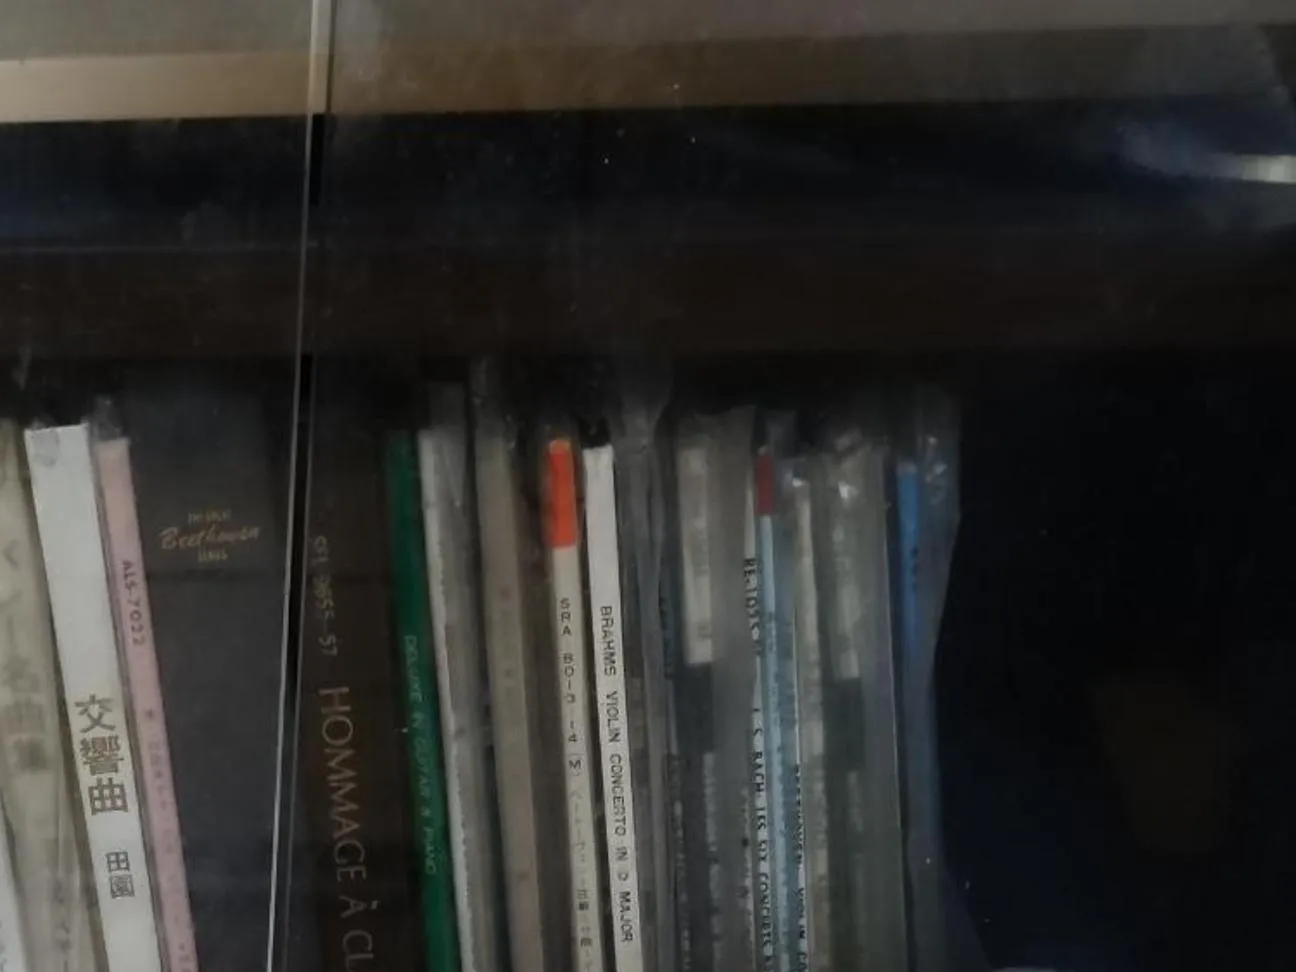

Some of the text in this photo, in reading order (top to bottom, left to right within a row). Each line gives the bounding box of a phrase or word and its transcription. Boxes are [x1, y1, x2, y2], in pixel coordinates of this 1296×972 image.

[600, 605, 618, 677] BRAHMS
[605, 689, 621, 744] VIOLIN
[75, 694, 129, 815] 交響曲
[318, 686, 368, 883] HOMMAGE
[610, 754, 628, 838] CONCERTO
[106, 850, 135, 898] 田園
[618, 847, 629, 861] IN
[620, 891, 635, 943] MAJOR
